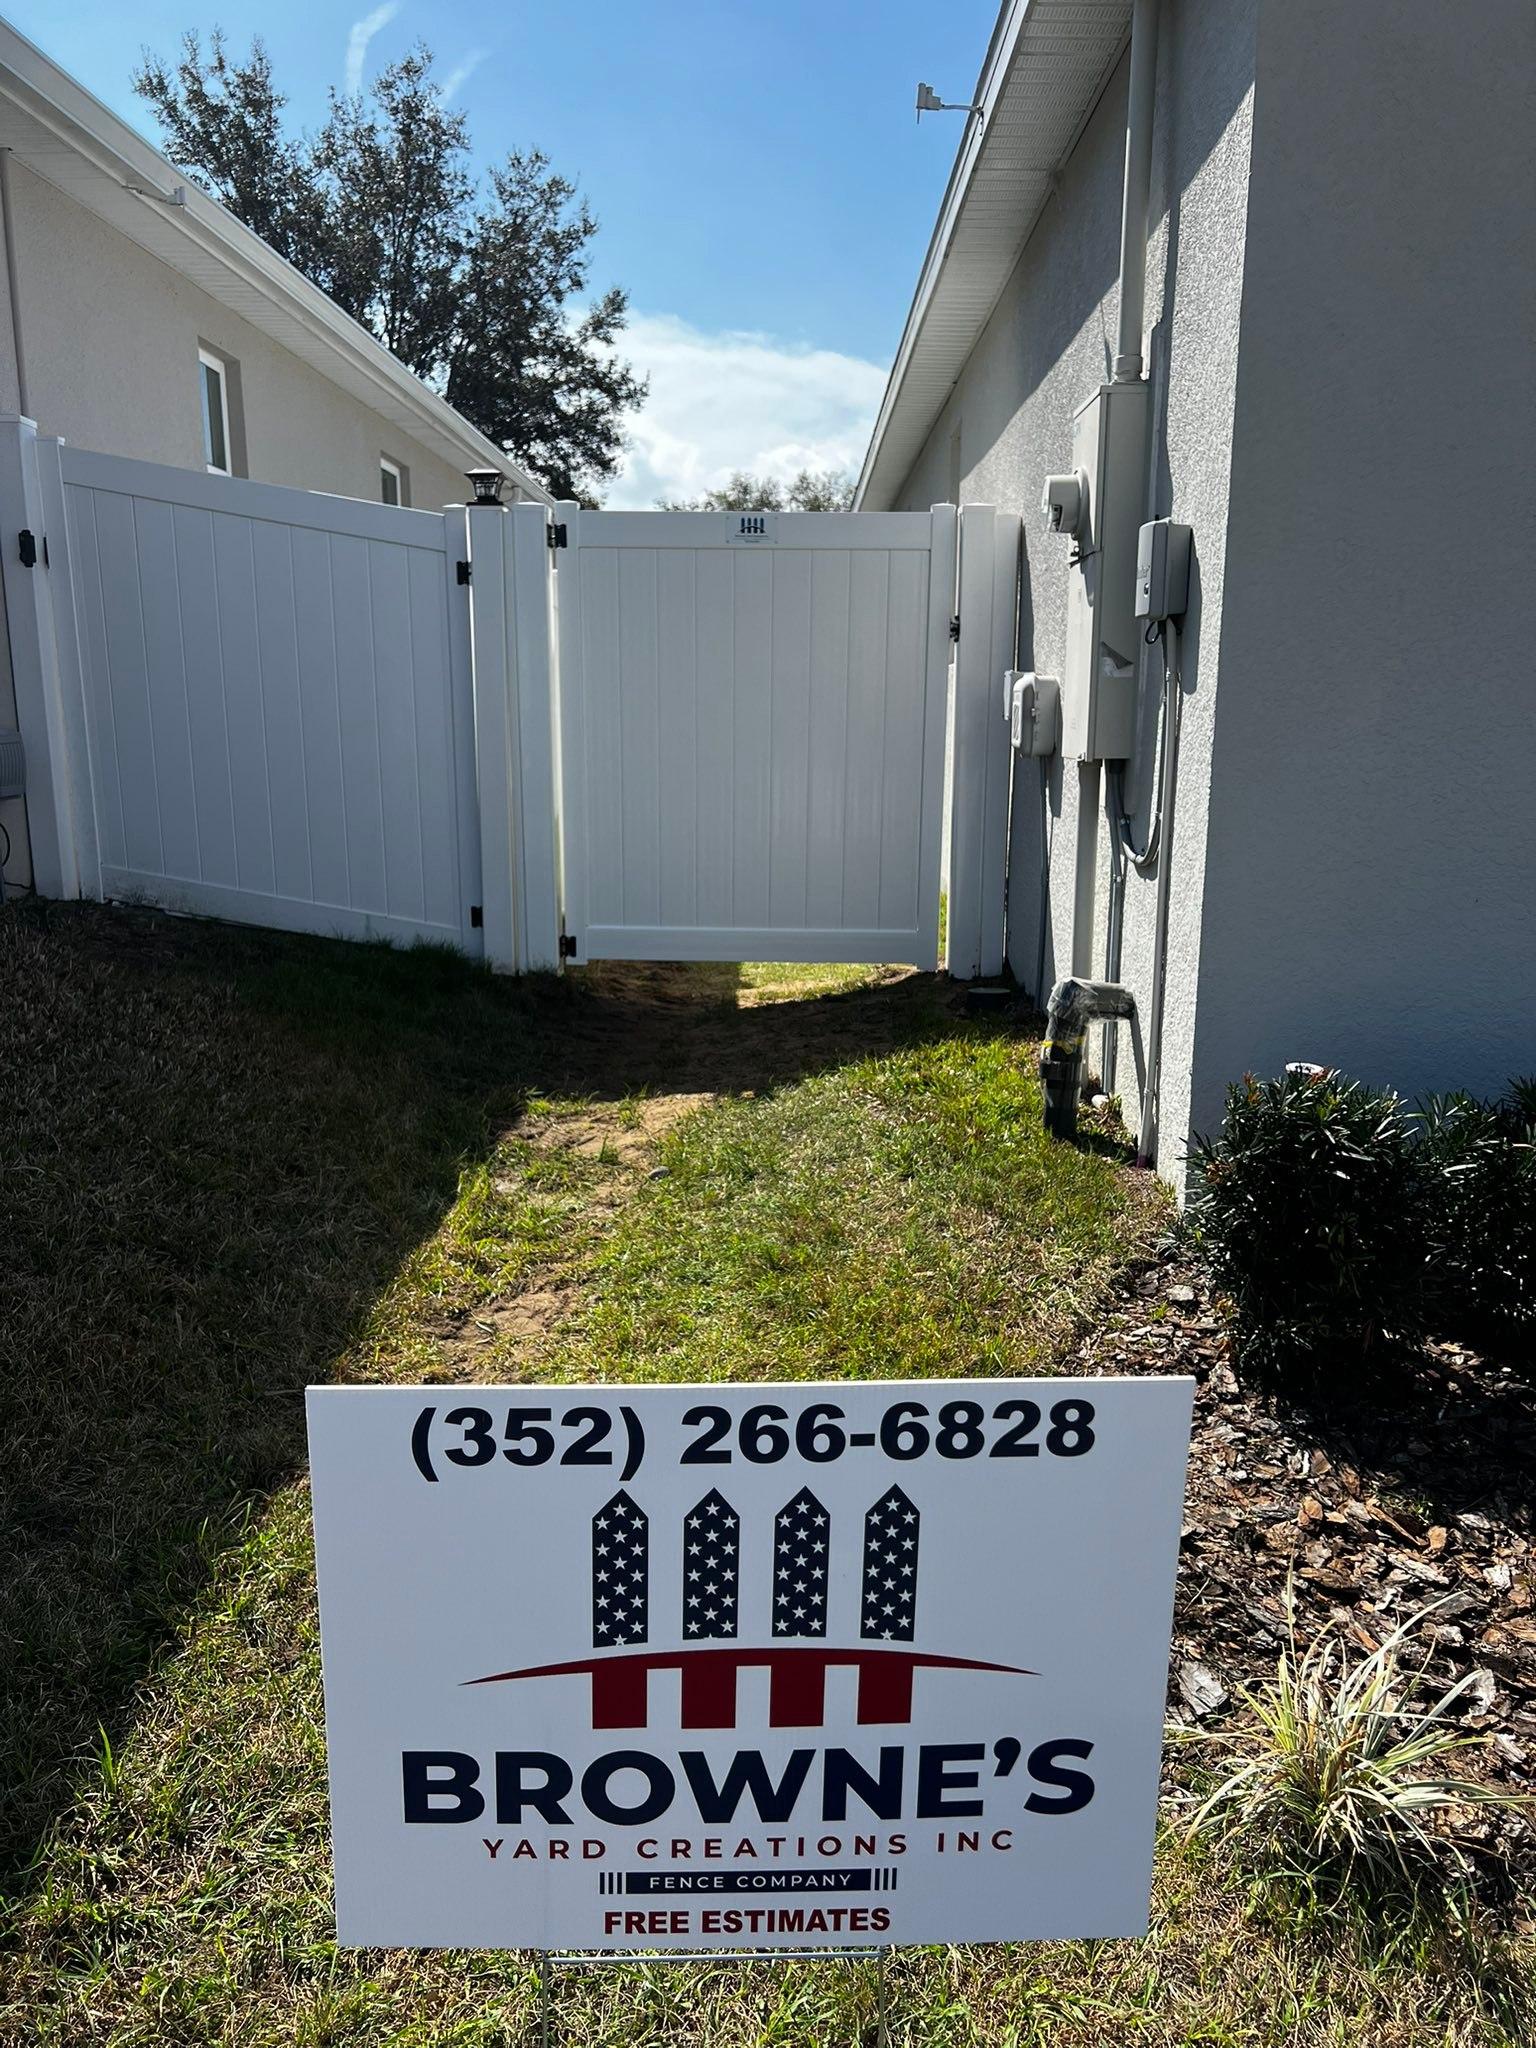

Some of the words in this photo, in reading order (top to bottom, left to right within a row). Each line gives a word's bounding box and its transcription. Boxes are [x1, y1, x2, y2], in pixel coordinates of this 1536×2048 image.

[412, 1406, 646, 1483] (352)
[680, 1399, 1096, 1465] 266-6828
[402, 1736, 1096, 1825] BROWNE'S
[482, 1838, 606, 1860] YARD
[636, 1833, 907, 1859] CREATIONS
[937, 1829, 1014, 1853] INC
[649, 1876, 725, 1889] FENCE
[736, 1873, 852, 1888] COMPANY
[604, 1911, 690, 1935] FREE
[701, 1907, 891, 1934] ESTIMATES
